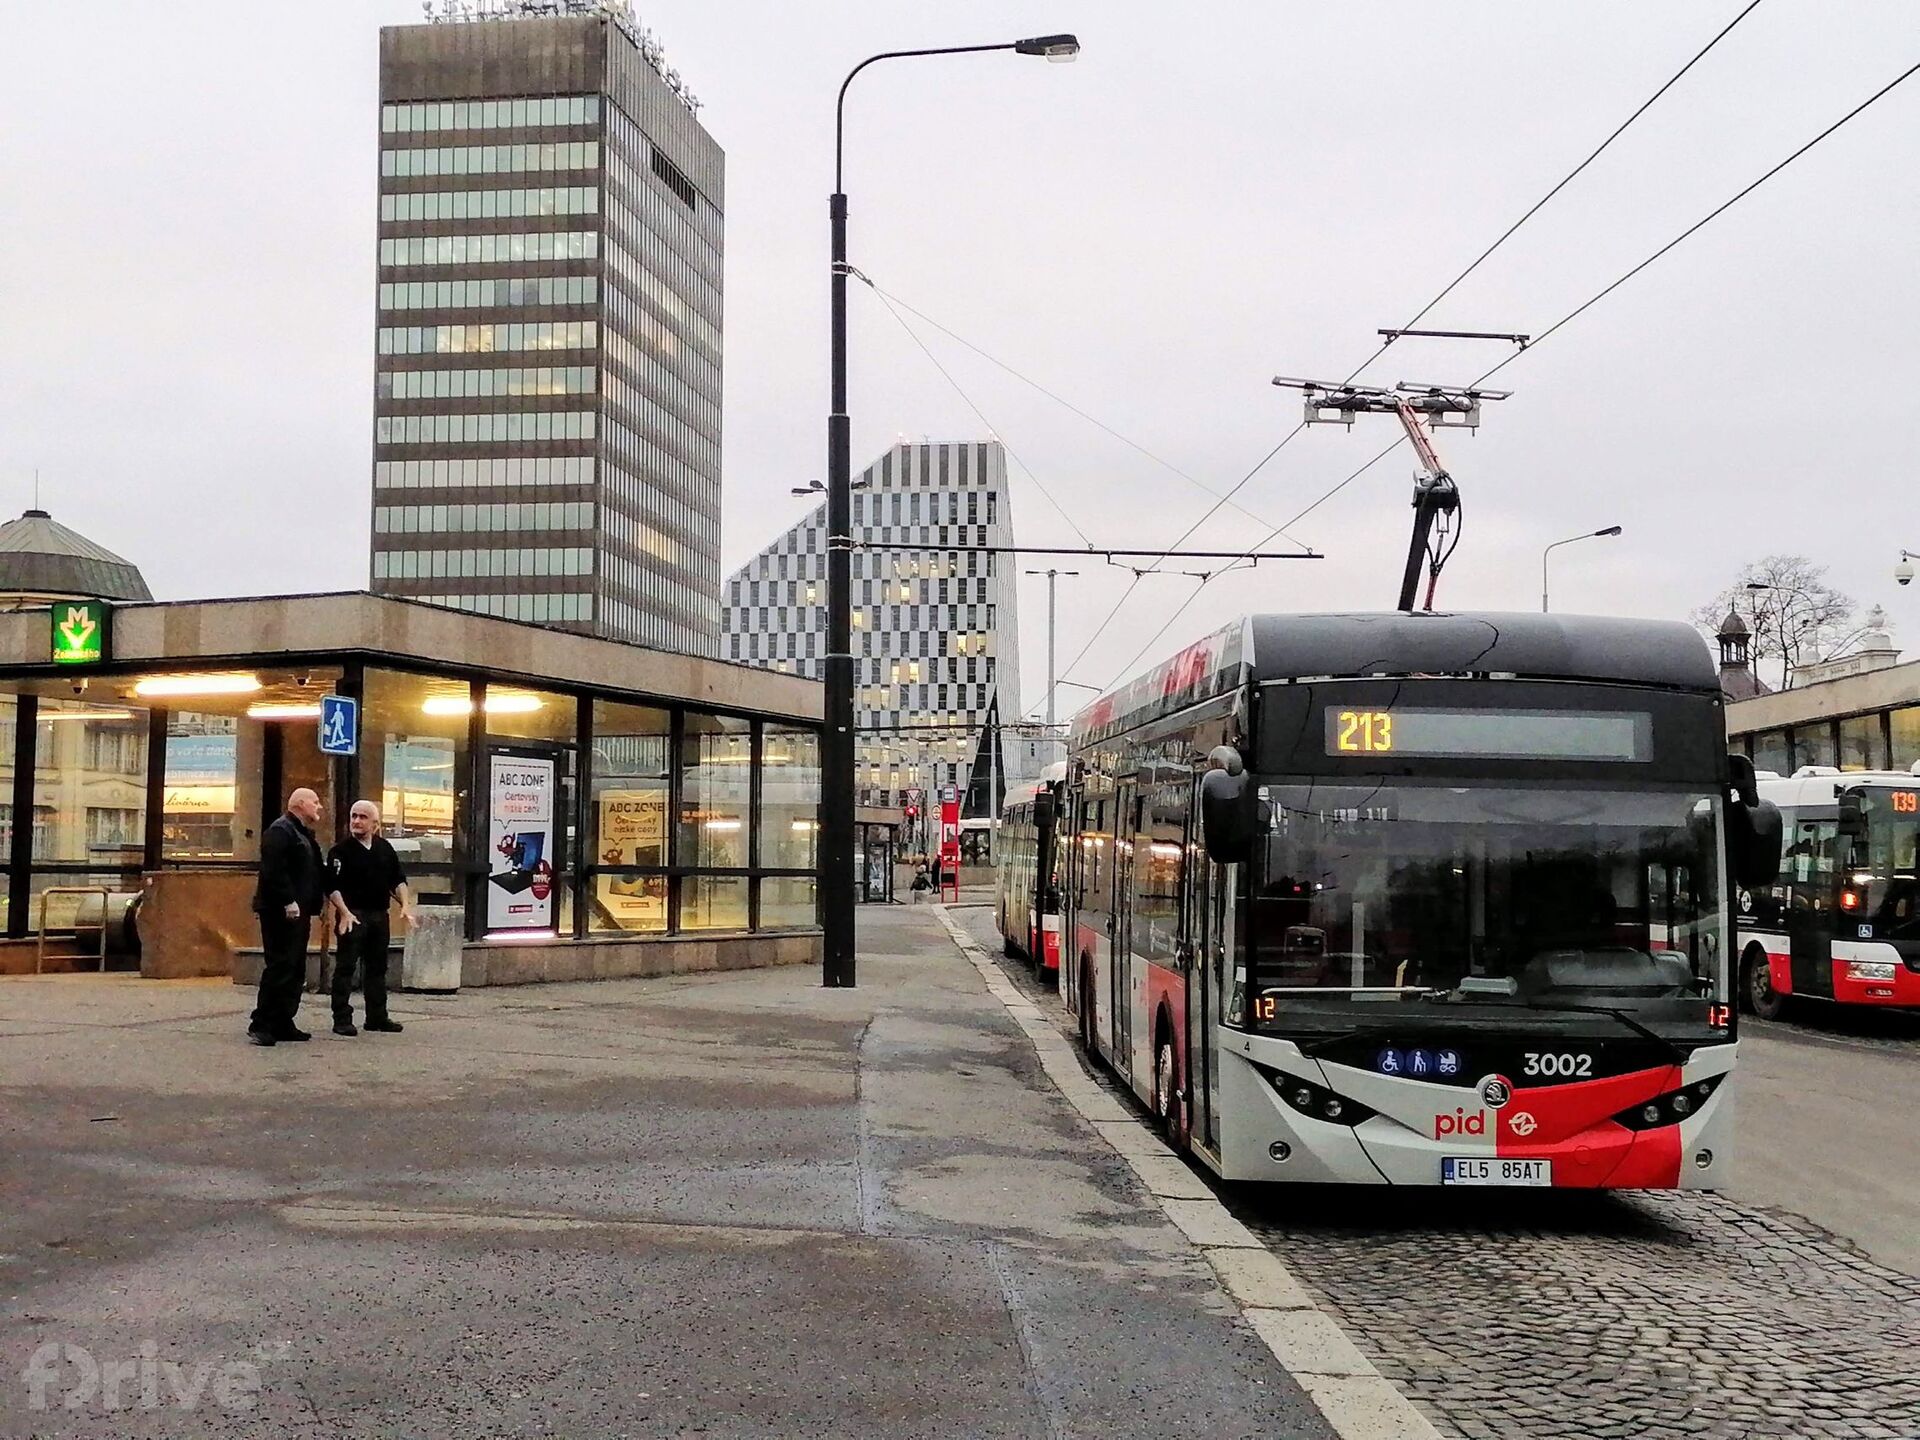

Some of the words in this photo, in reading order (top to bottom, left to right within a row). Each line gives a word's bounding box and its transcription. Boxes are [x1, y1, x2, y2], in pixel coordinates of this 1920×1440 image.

[1339, 711, 1392, 751] 213
[499, 773, 519, 786] ABC
[520, 774, 545, 788] ZONE
[608, 802, 632, 813] ABC
[634, 802, 664, 813] ZONE
[1891, 791, 1917, 812] 139
[1255, 997, 1275, 1018] 12
[1710, 1006, 1729, 1026] 12
[1523, 1053, 1593, 1077] 3002
[1435, 1106, 1485, 1141] pid
[1458, 1161, 1490, 1179] EL5
[1502, 1162, 1543, 1180] 85AT
